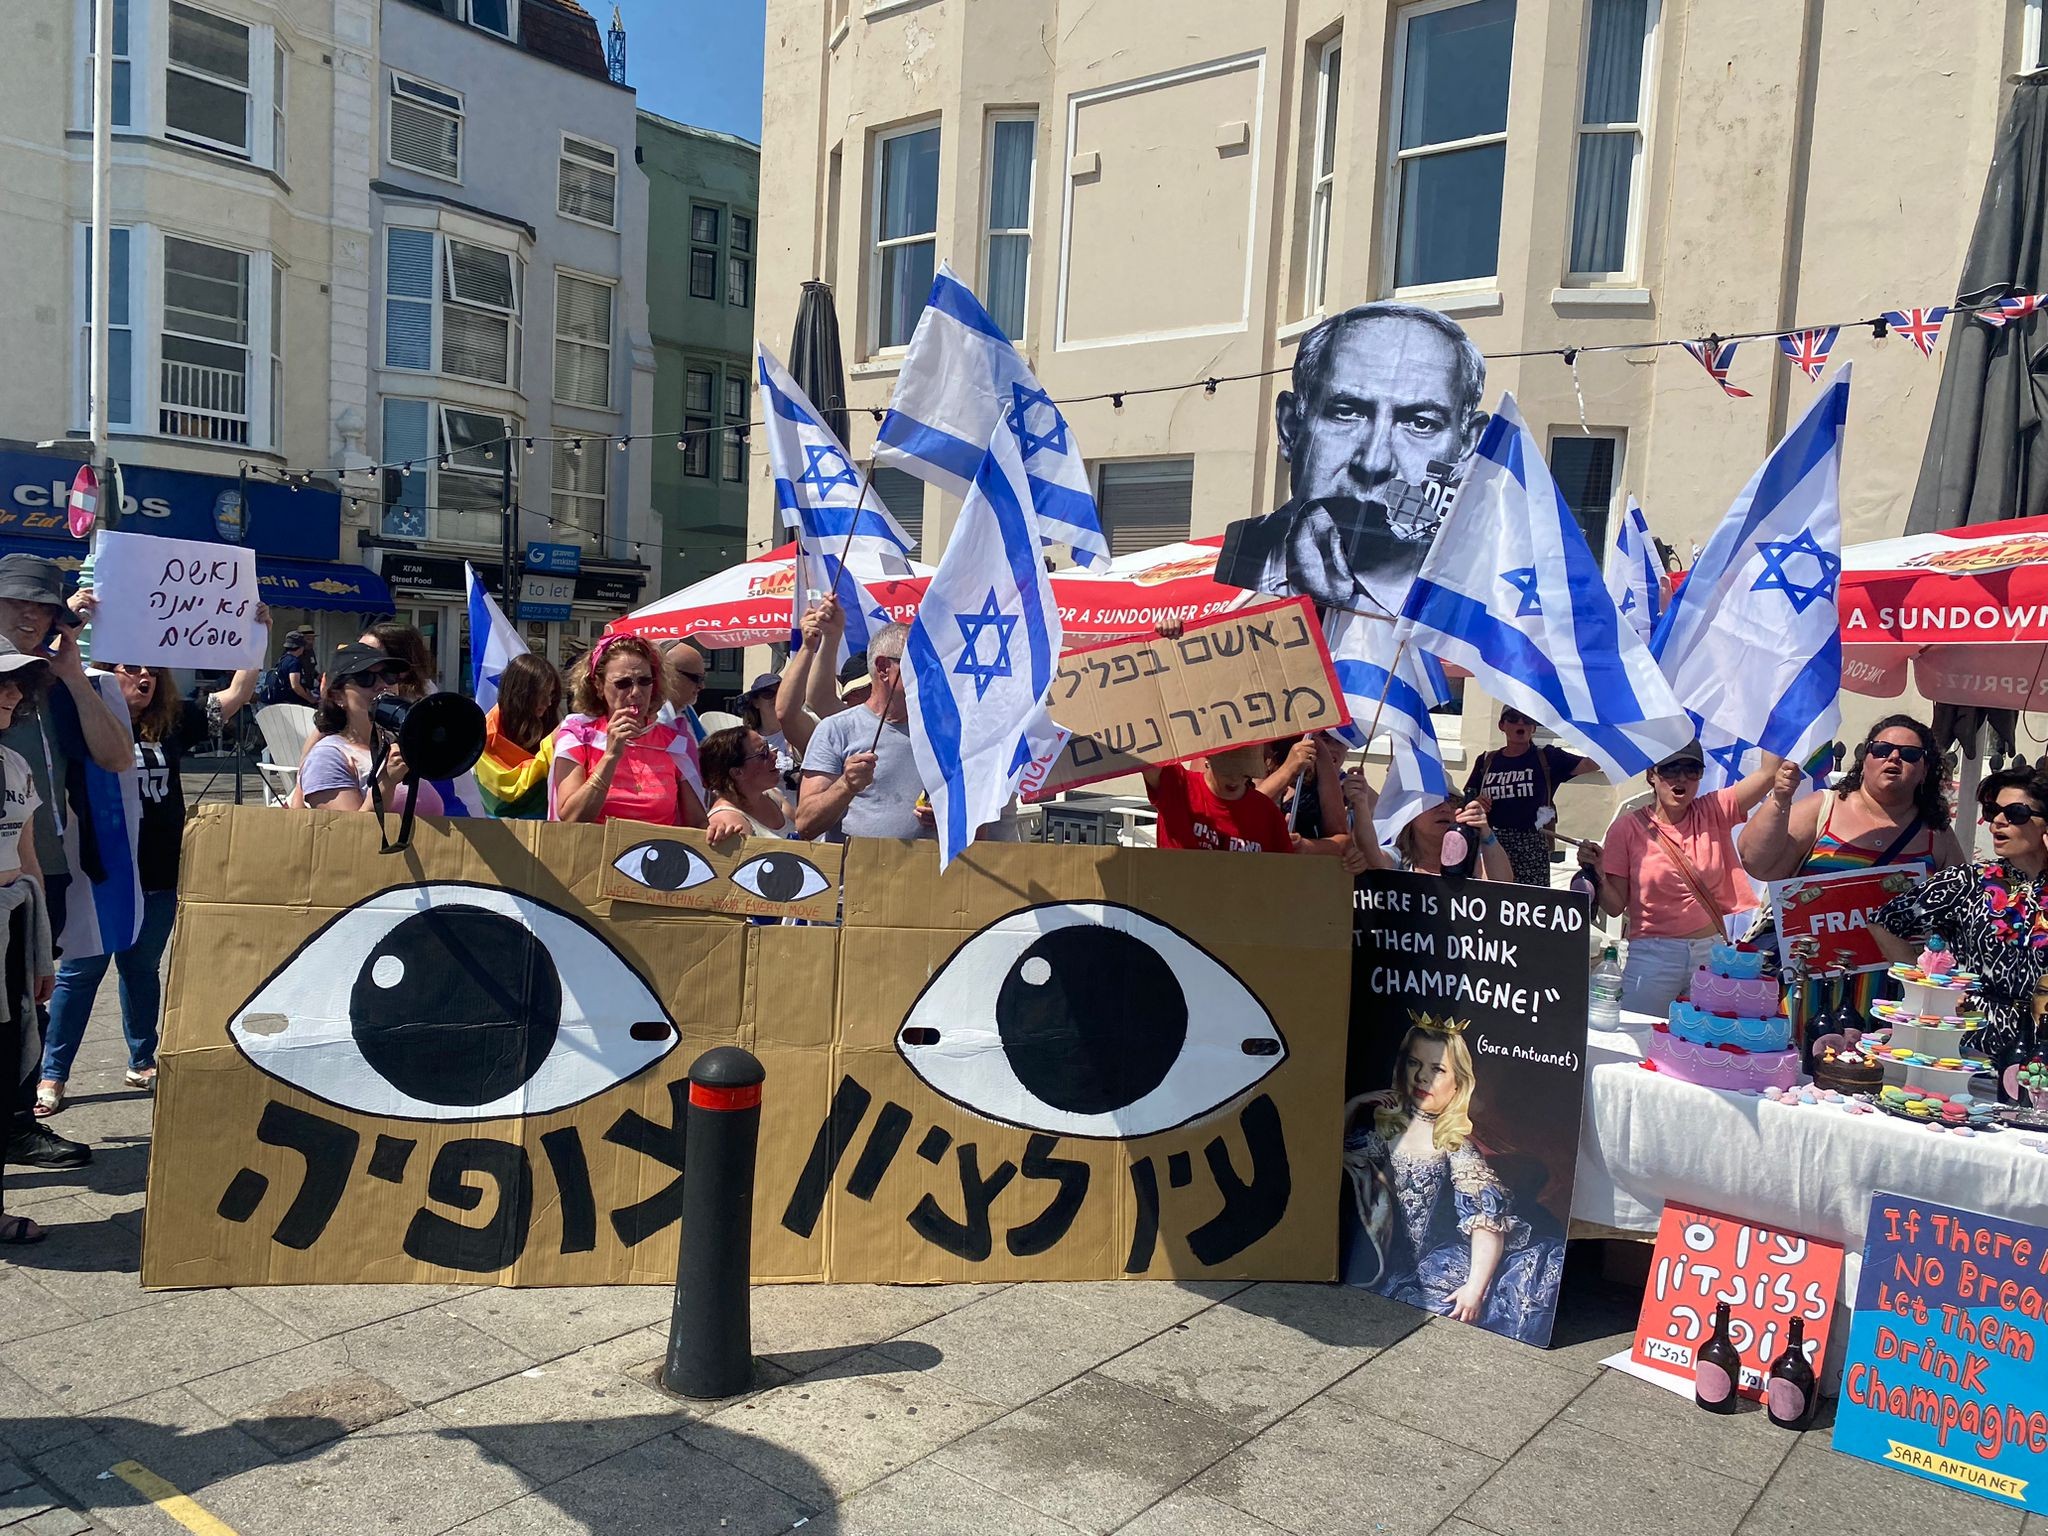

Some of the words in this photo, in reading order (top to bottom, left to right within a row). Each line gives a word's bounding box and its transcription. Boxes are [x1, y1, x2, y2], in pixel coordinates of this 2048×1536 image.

[13, 480, 171, 518] chps
[22, 512, 63, 528] Eat
[159, 558, 238, 590] נאשם
[281, 575, 300, 588] in
[391, 575, 412, 584] Street
[413, 576, 432, 585] Food
[528, 582, 545, 597] to
[549, 582, 569, 598] let
[150, 591, 205, 621] ימנה
[215, 598, 250, 618] לא
[633, 626, 679, 636] TIME
[685, 619, 722, 632] FOR
[728, 616, 742, 626] A
[748, 612, 794, 625] SUN
[1078, 608, 1090, 623] A
[1094, 604, 1198, 625] SUNDOWNER
[1847, 607, 1868, 629] A
[158, 619, 243, 648] שופטים
[1176, 614, 1311, 666] נאשם
[1168, 685, 1327, 740] מפקיר
[1068, 716, 1164, 768] נשים
[645, 892, 705, 907] WATCHING
[745, 898, 781, 914] EVERY
[789, 904, 821, 918] MOVE
[1421, 893, 1439, 916] IS
[1451, 895, 1487, 922] NO
[1500, 900, 1583, 932] BREAD
[1809, 906, 1881, 936] FRA
[1371, 928, 1435, 956] THEM
[1447, 928, 1518, 968] DRINK
[1477, 1034, 1509, 1056] (Sara
[1512, 1044, 1579, 1073] Antuanet)
[781, 1074, 1090, 1262] לציון
[1124, 1093, 1291, 1273] עין
[1735, 1225, 1807, 1269] עין
[1883, 1208, 1921, 1244] If
[1930, 1213, 2033, 1268] There
[1877, 1280, 1930, 1326] Let
[1940, 1301, 2035, 1363] Them
[1846, 1362, 2048, 1460] Champagne
[1893, 1445, 1933, 1470] SARA
[1938, 1459, 2019, 1495] ANTUANET
